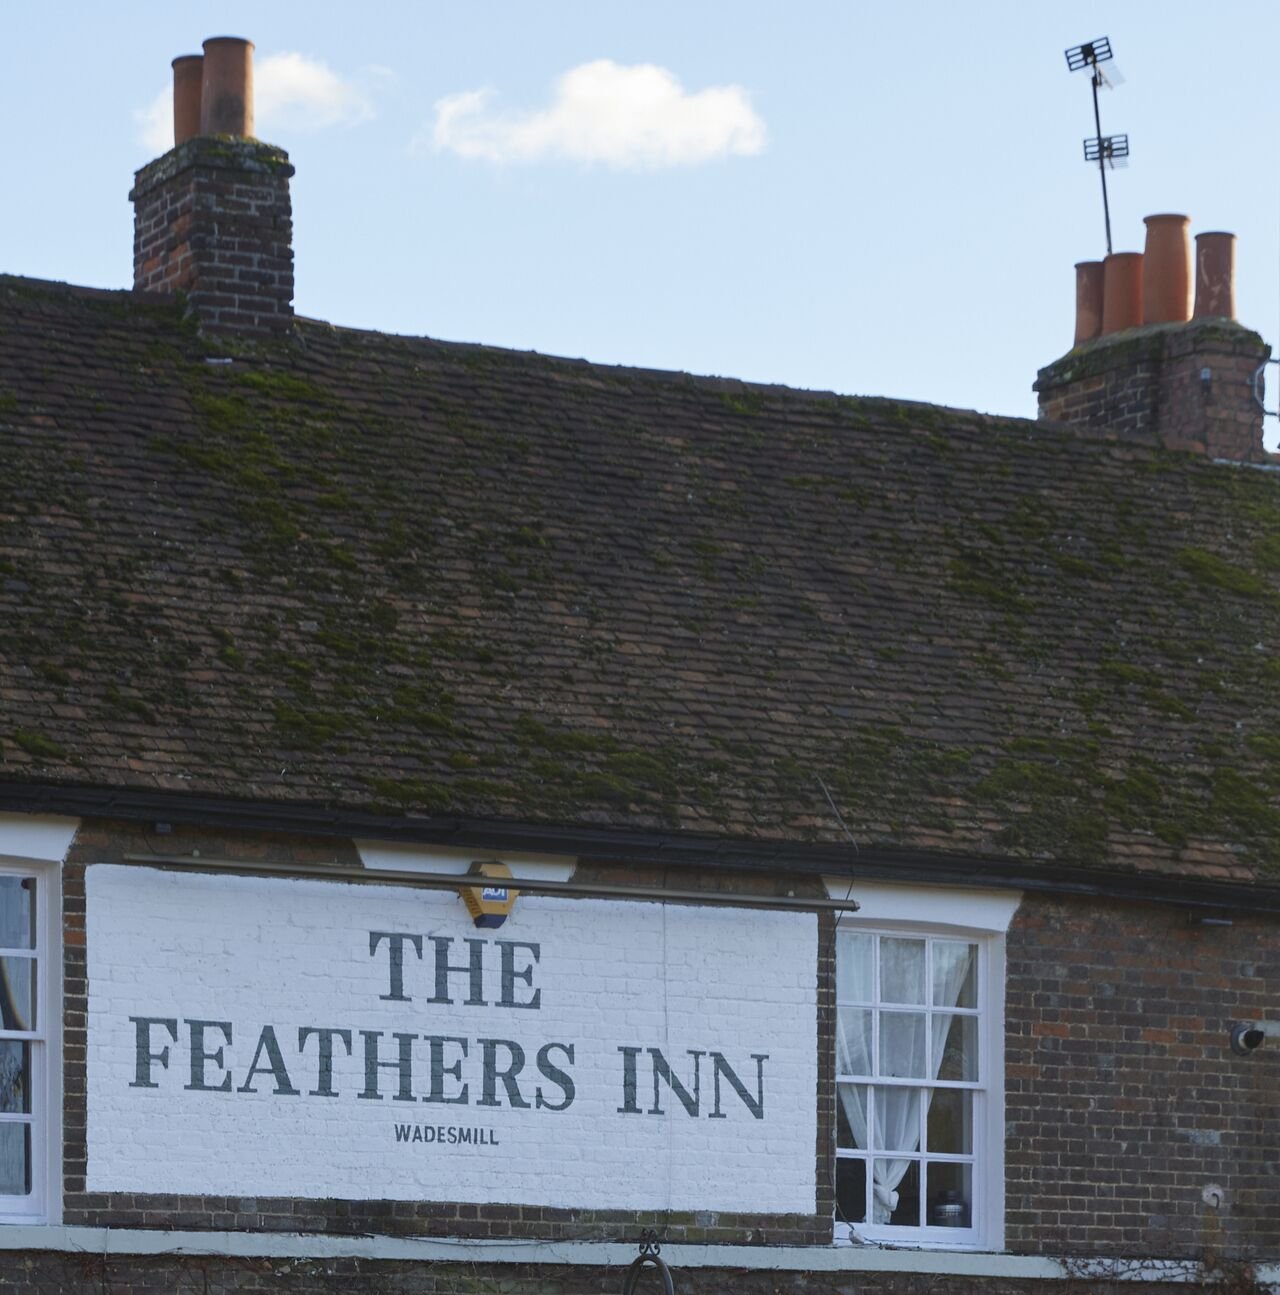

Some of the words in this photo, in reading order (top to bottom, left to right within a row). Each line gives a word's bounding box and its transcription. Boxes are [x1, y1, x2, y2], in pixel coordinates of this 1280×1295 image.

[369, 931, 541, 1010] THE
[128, 1016, 576, 1111] FEATHERS
[617, 1046, 770, 1119] INN
[394, 1123, 500, 1146] WADESMILL
